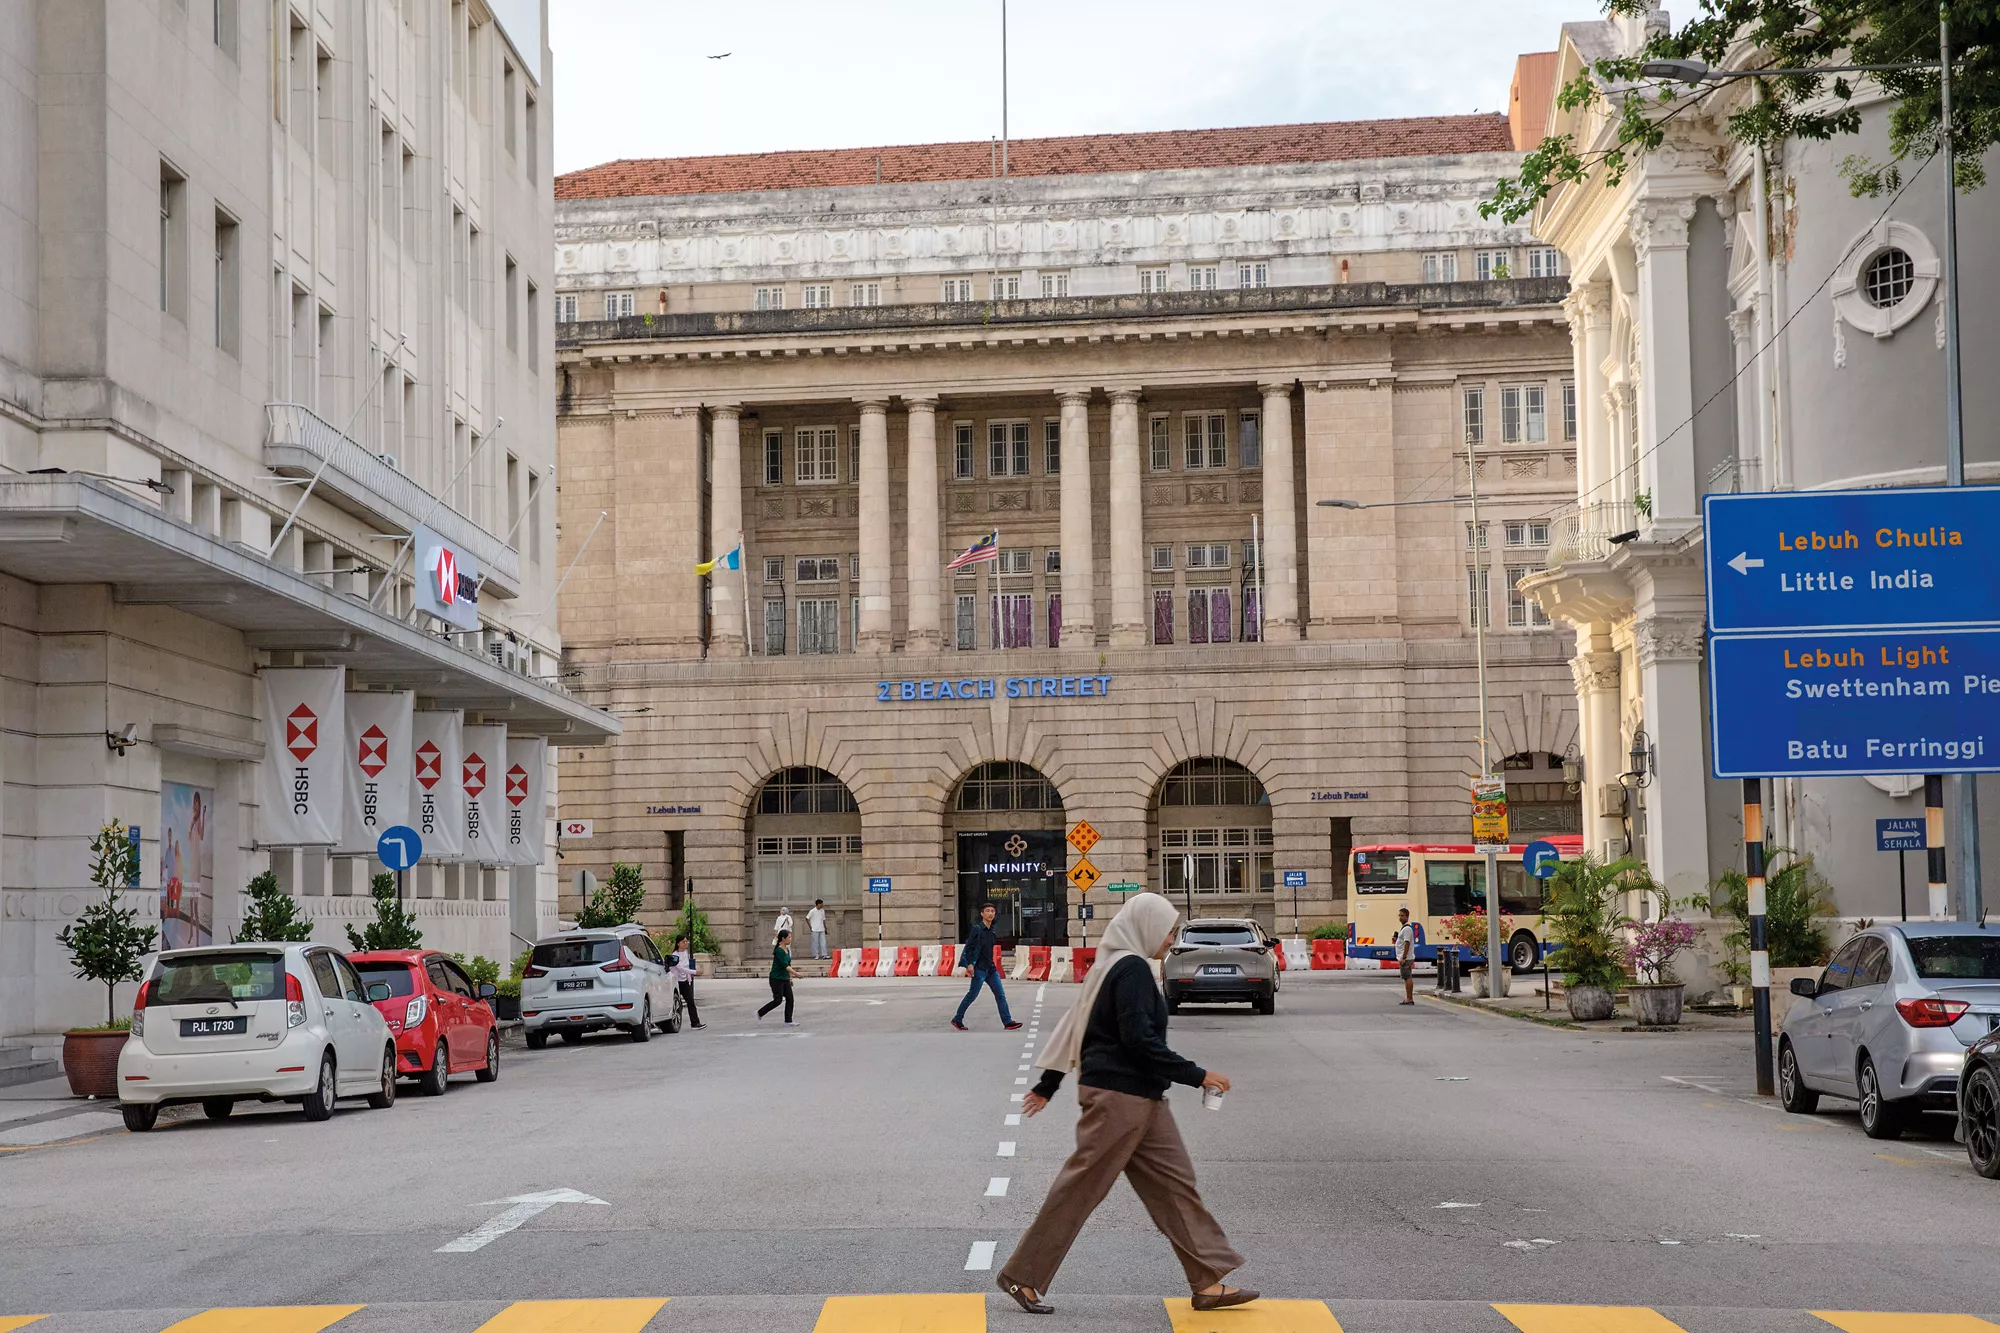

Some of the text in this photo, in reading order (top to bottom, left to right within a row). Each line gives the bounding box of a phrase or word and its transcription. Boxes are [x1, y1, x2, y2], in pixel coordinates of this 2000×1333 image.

[1779, 526, 1963, 551] Lebuh Chulia
[1780, 569, 1934, 592] Little India
[1783, 645, 1950, 669] Lebuh Light
[877, 675, 1112, 701] 2 BEACH STREET
[1785, 676, 1950, 698] Swettenham
[1788, 735, 1984, 760] Batu Ferringgi
[294, 767, 309, 815] HSBC
[1311, 791, 1369, 800] 2 Lebuh Pantai
[364, 783, 378, 827] HSBC
[422, 794, 434, 834] HSBC
[646, 805, 701, 814] 2 Lebuh Pantai
[468, 802, 479, 839] HSBC
[510, 809, 521, 845] HSBC
[1887, 821, 1917, 830] JALAN
[1884, 839, 1921, 849] SEHALA
[192, 1020, 234, 1032] PJL 1730
